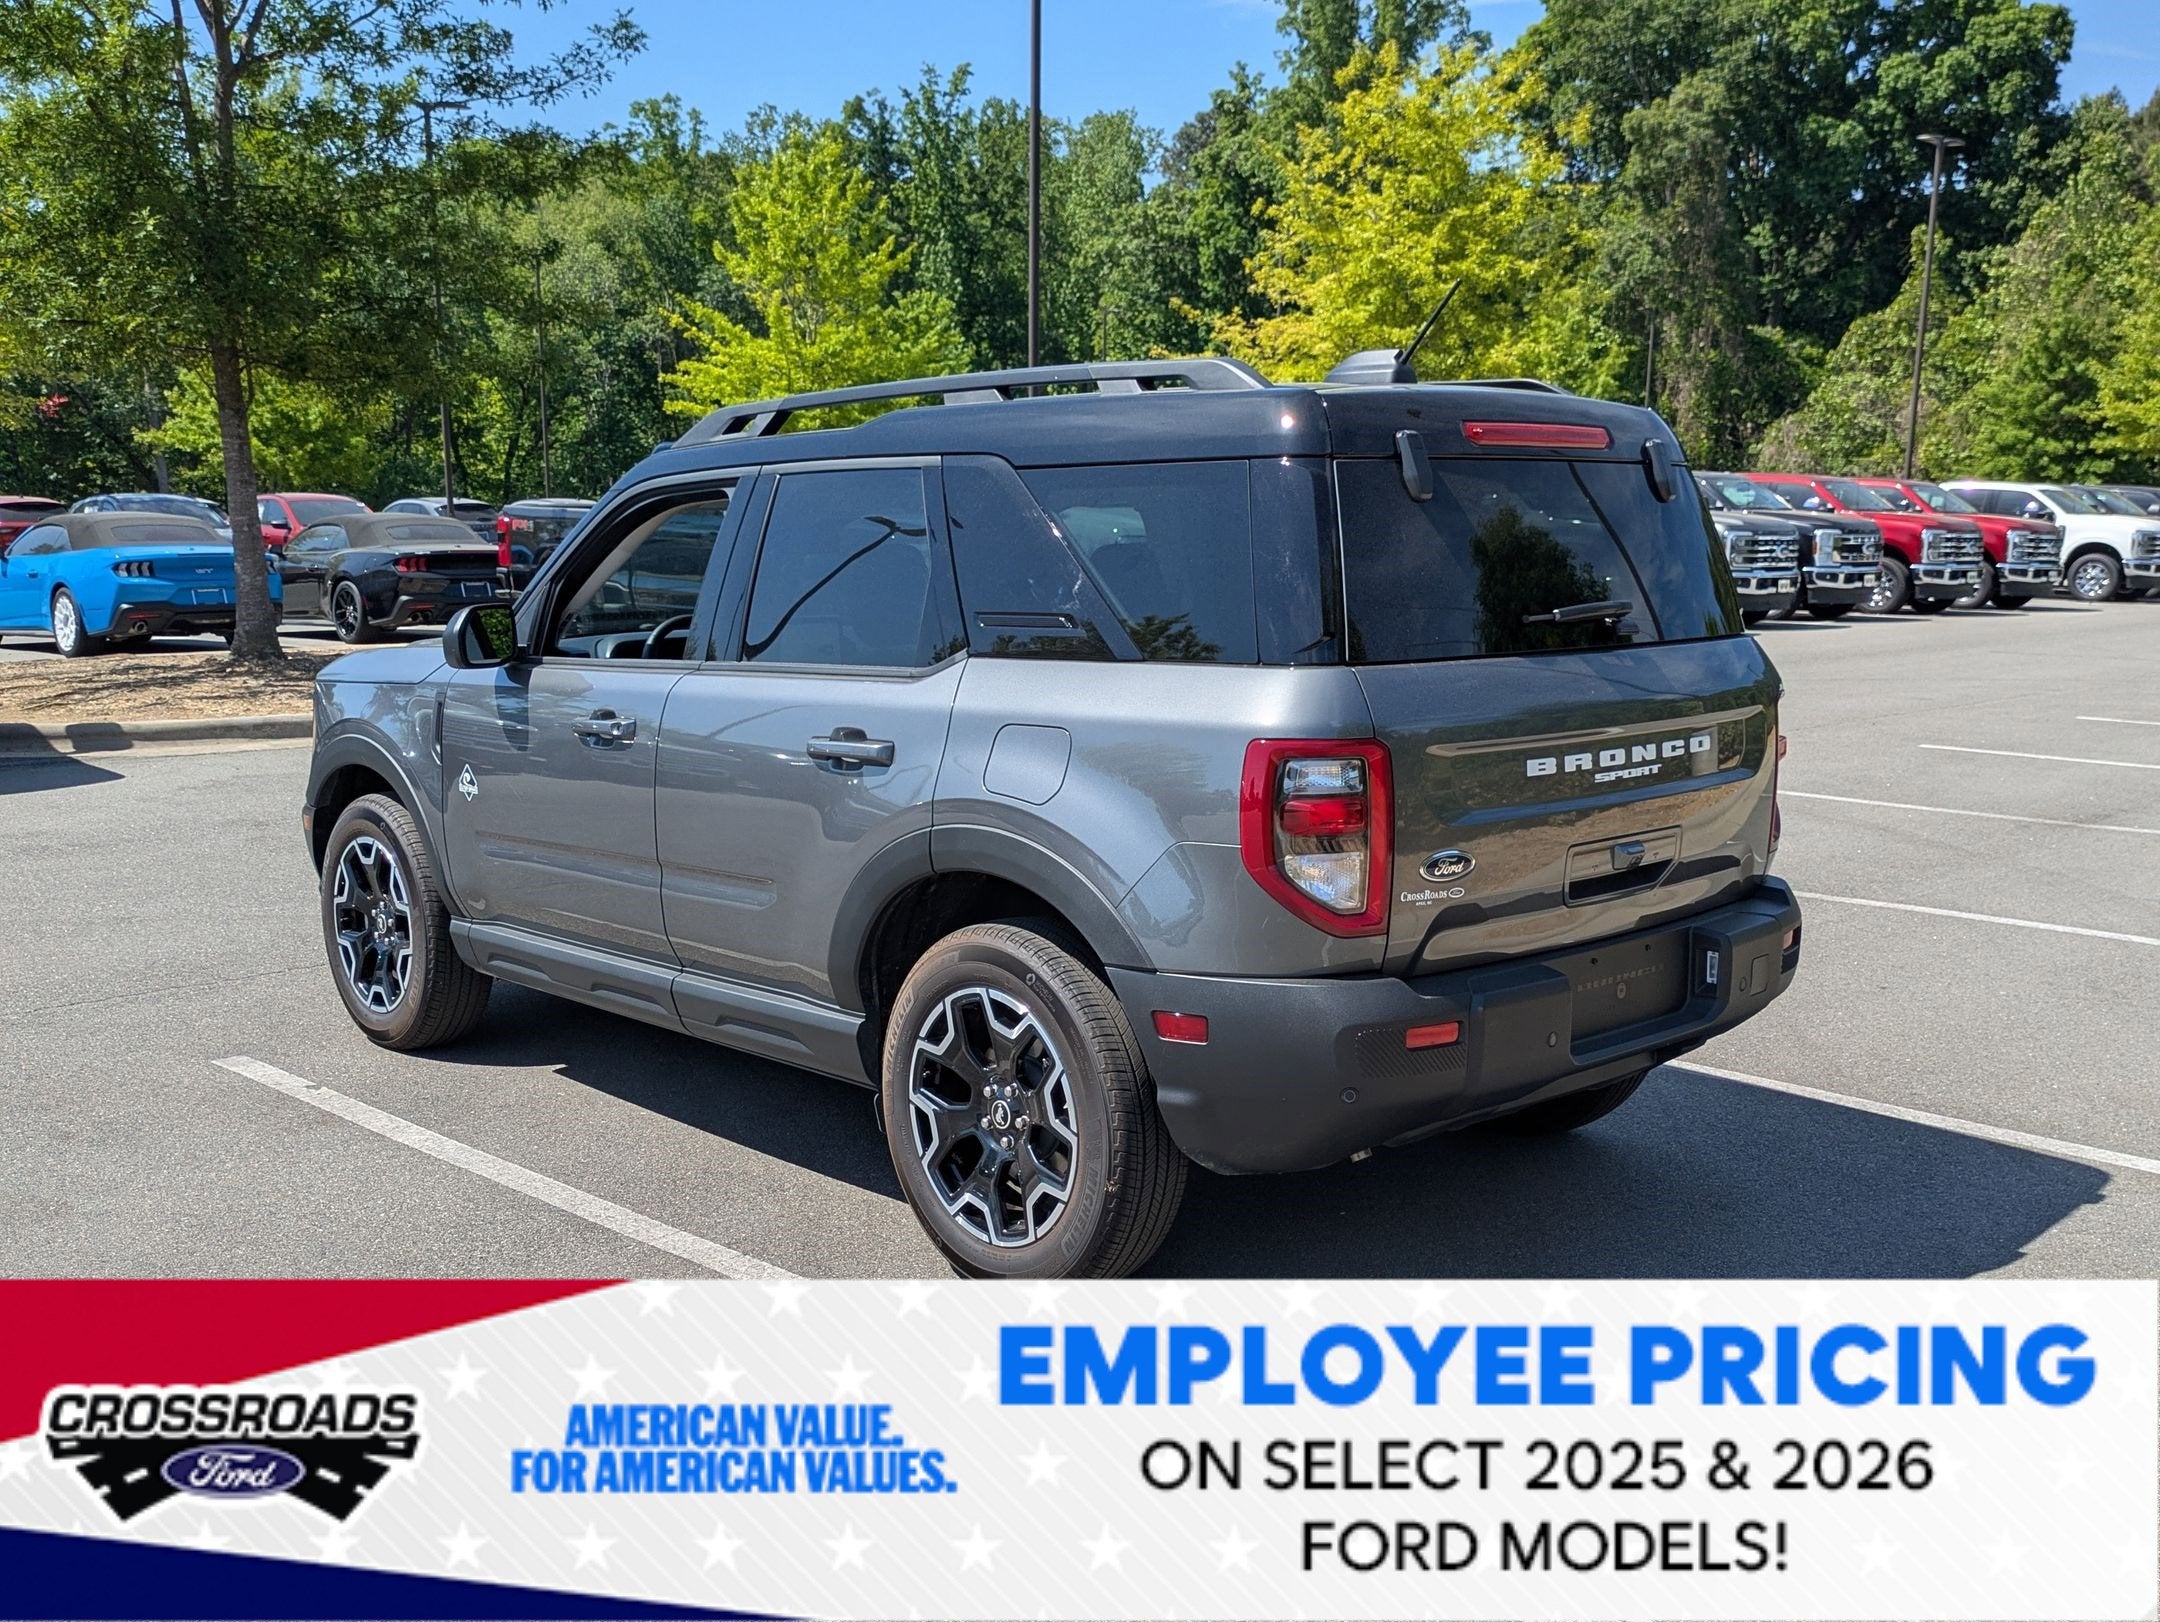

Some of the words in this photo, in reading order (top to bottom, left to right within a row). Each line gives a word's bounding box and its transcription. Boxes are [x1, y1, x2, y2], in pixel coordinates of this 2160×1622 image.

[1526, 735, 1711, 777] BRONCO
[1594, 764, 1662, 783] SPORT
[1434, 858, 1465, 876] Ford
